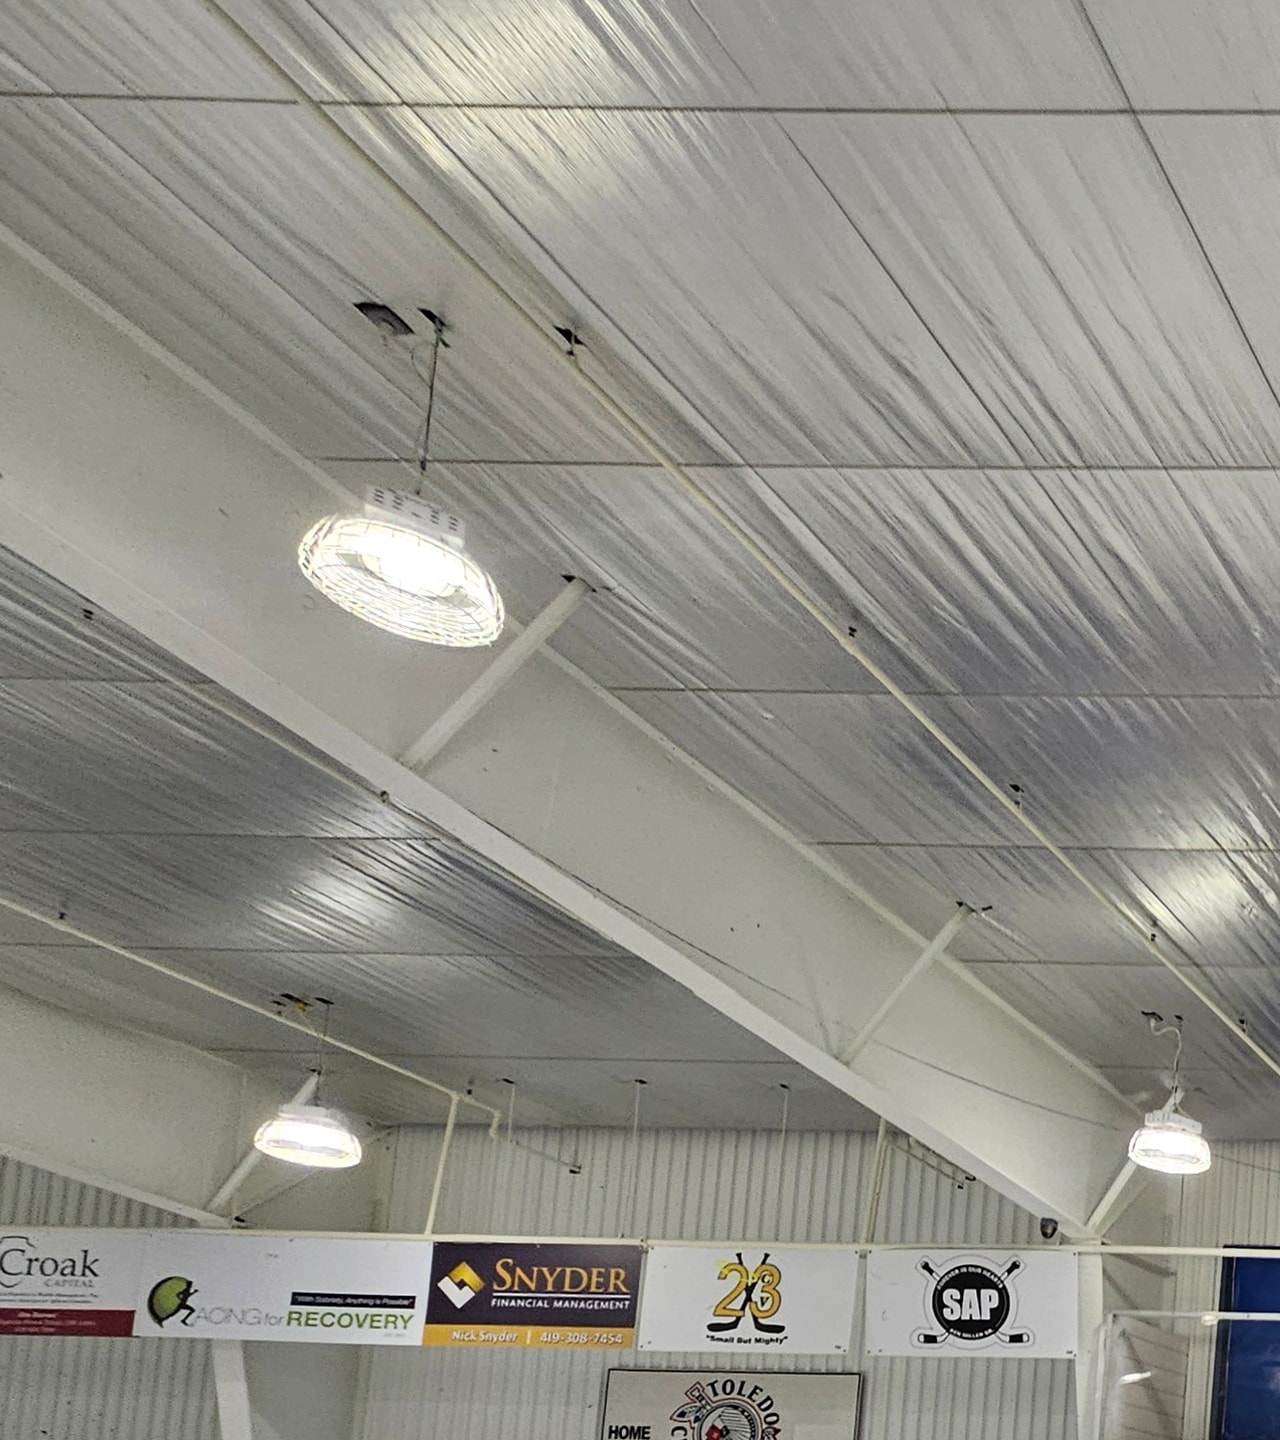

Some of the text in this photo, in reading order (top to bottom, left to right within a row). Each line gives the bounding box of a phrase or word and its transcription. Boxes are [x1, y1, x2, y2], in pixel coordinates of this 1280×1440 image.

[0, 1248, 99, 1277] Croak
[493, 1258, 630, 1293] SNYDER
[713, 1263, 782, 1319] 23
[491, 1298, 630, 1311] FINANCIAL MANAGEMENT
[942, 1288, 999, 1321] SAP
[286, 1310, 414, 1330] RECOVERY
[451, 1330, 476, 1341] Nick
[479, 1330, 518, 1344] Snyder
[736, 1337, 752, 1345] But
[706, 1379, 780, 1426] TOLEDO
[608, 1425, 651, 1440] HOME
